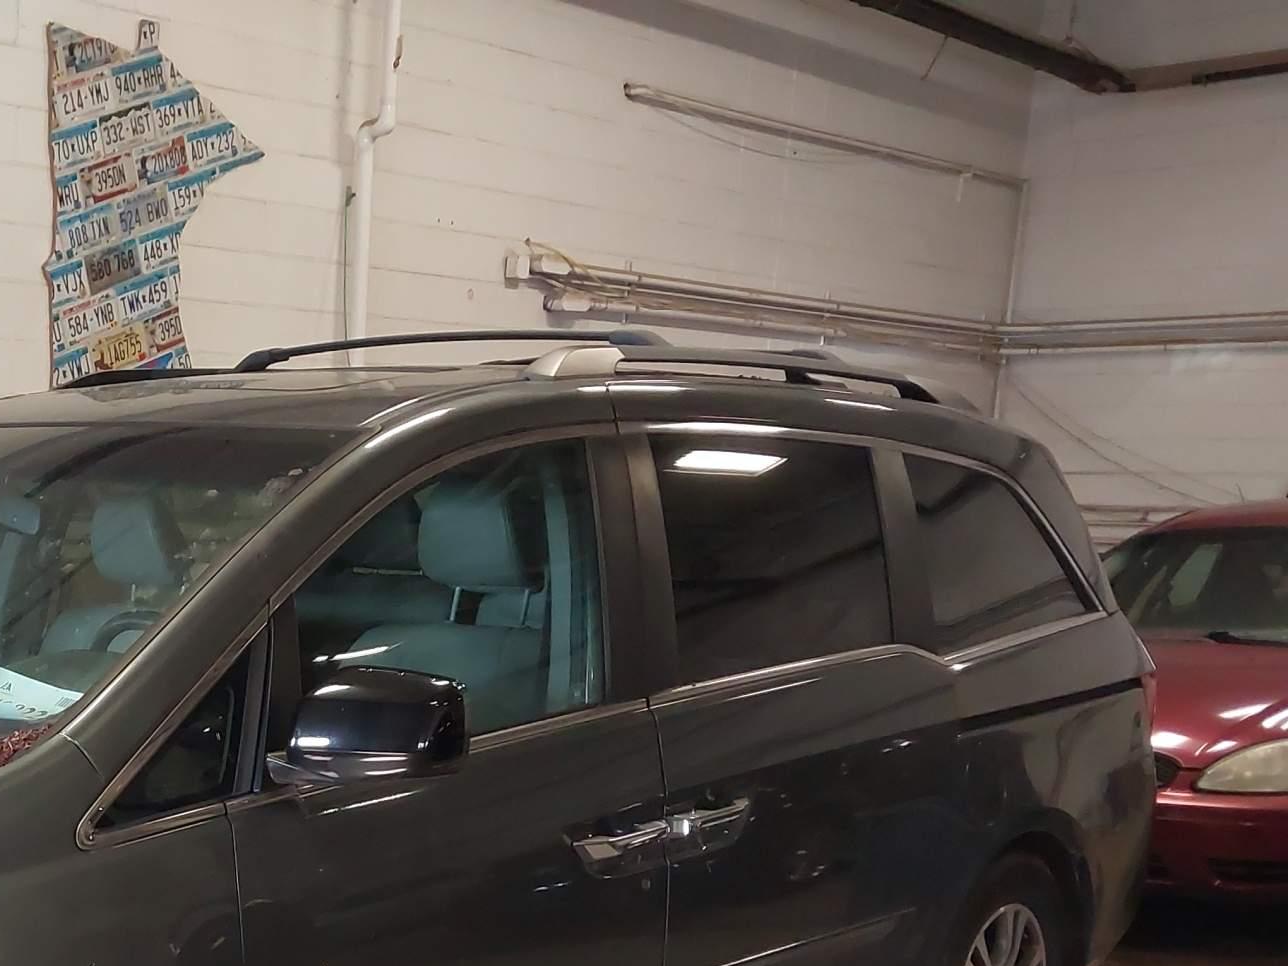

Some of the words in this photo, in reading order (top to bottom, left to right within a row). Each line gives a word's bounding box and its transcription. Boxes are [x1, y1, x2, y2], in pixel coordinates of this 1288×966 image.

[148, 22, 156, 44] P
[114, 72, 137, 97] 940
[142, 64, 165, 89] RHR
[156, 104, 176, 129] 369
[76, 130, 98, 156] UXP
[191, 137, 210, 161] ADY
[119, 207, 142, 234] 524
[68, 223, 89, 249] 808
[114, 248, 136, 273] 768
[143, 239, 163, 263] 448
[62, 268, 86, 295] VJX
[119, 289, 144, 317] TWK
[148, 280, 168, 305] 459
